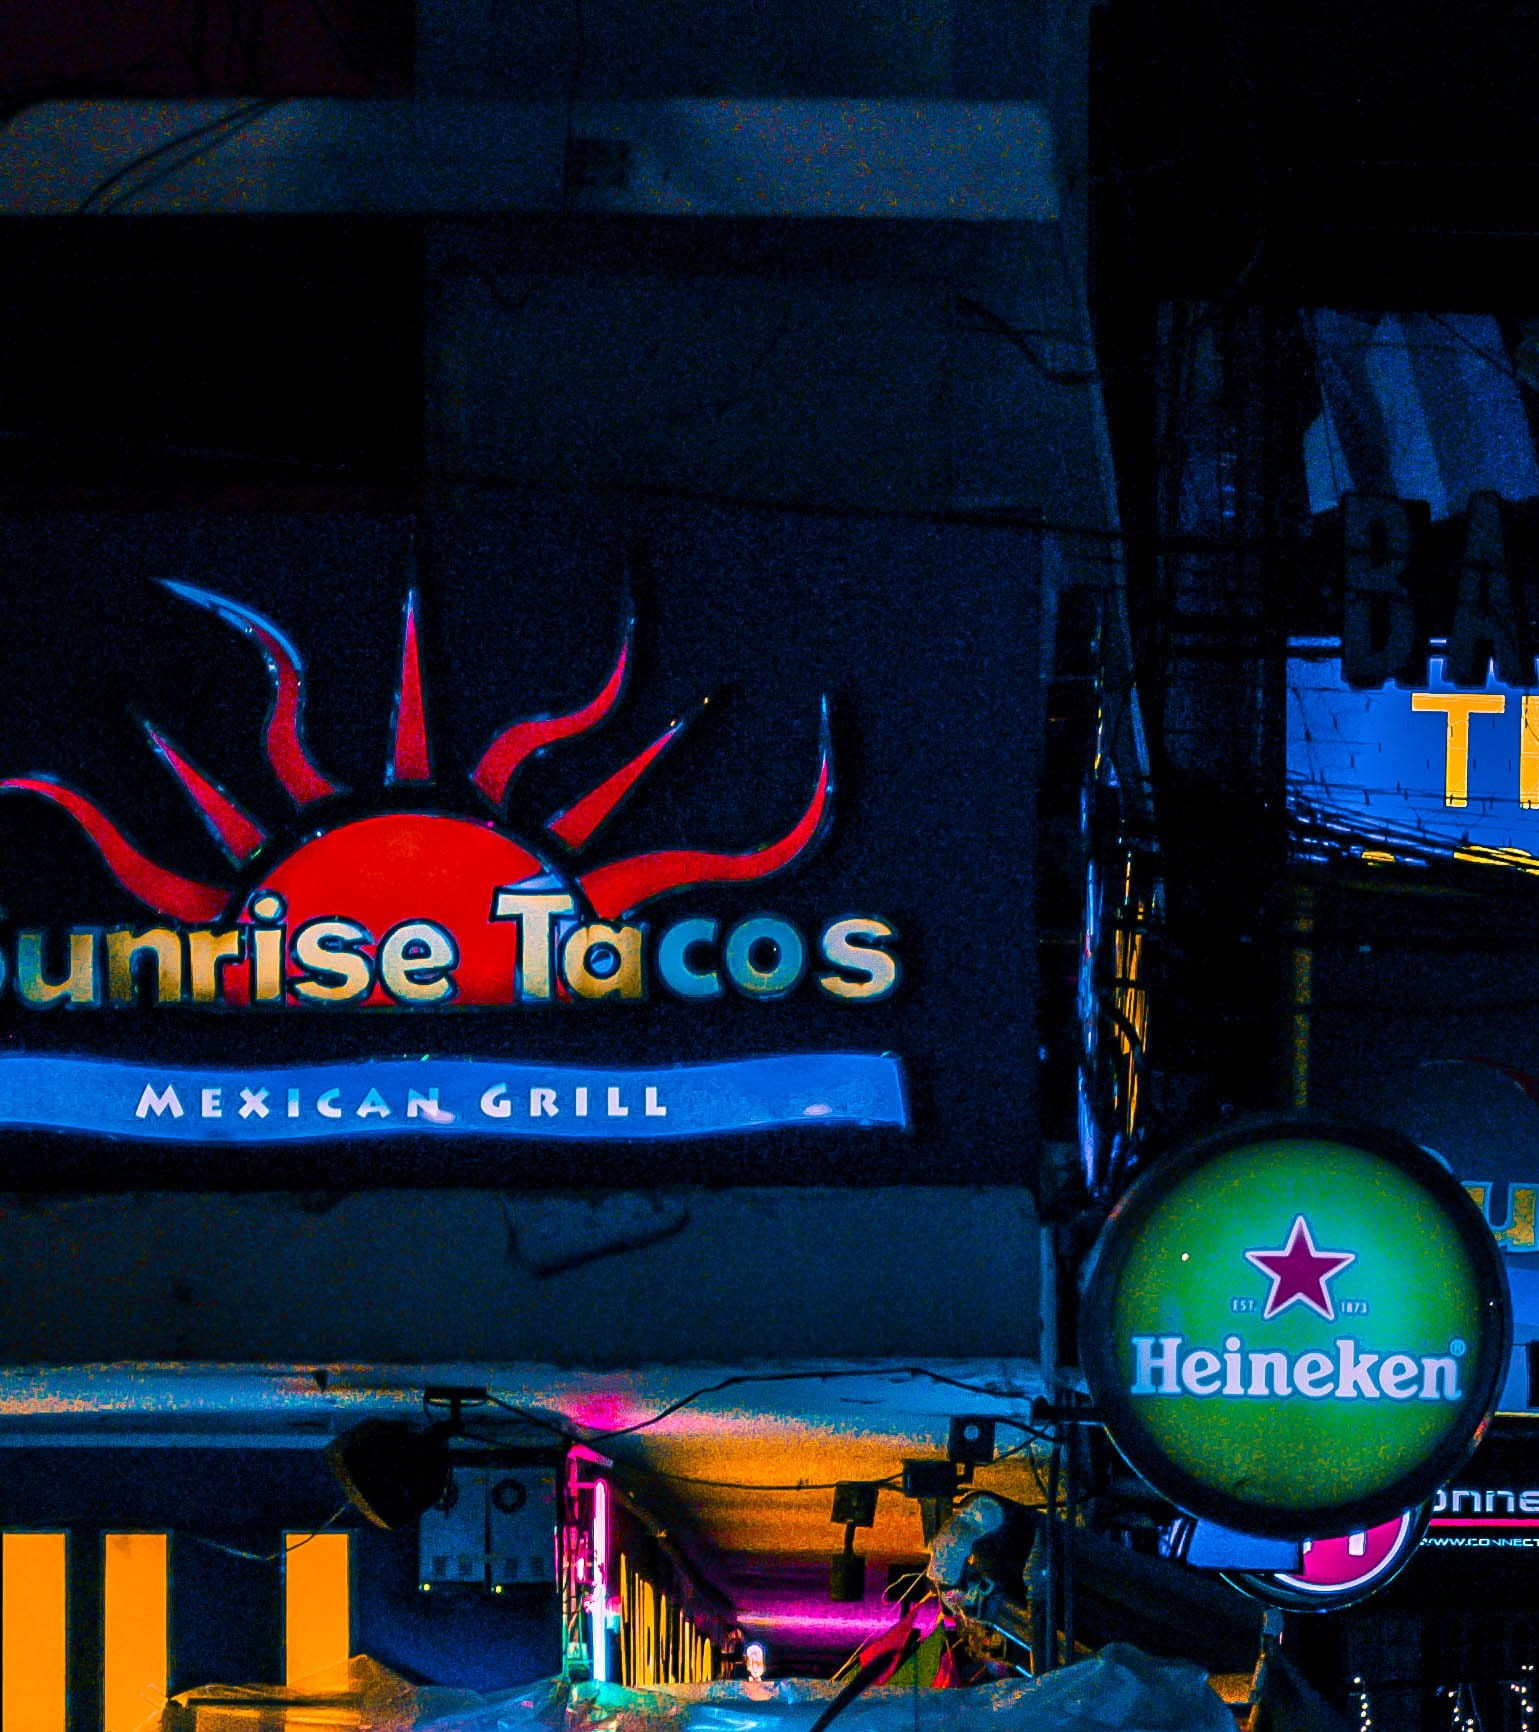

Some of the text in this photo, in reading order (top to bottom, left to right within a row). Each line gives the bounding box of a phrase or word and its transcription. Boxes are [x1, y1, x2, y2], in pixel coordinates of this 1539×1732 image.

[0, 887, 899, 1004] unrise Tacos
[134, 1083, 668, 1121] MEXICAN GRILL
[1231, 1298, 1257, 1313] EST.
[1129, 1335, 1464, 1401] Heineken
